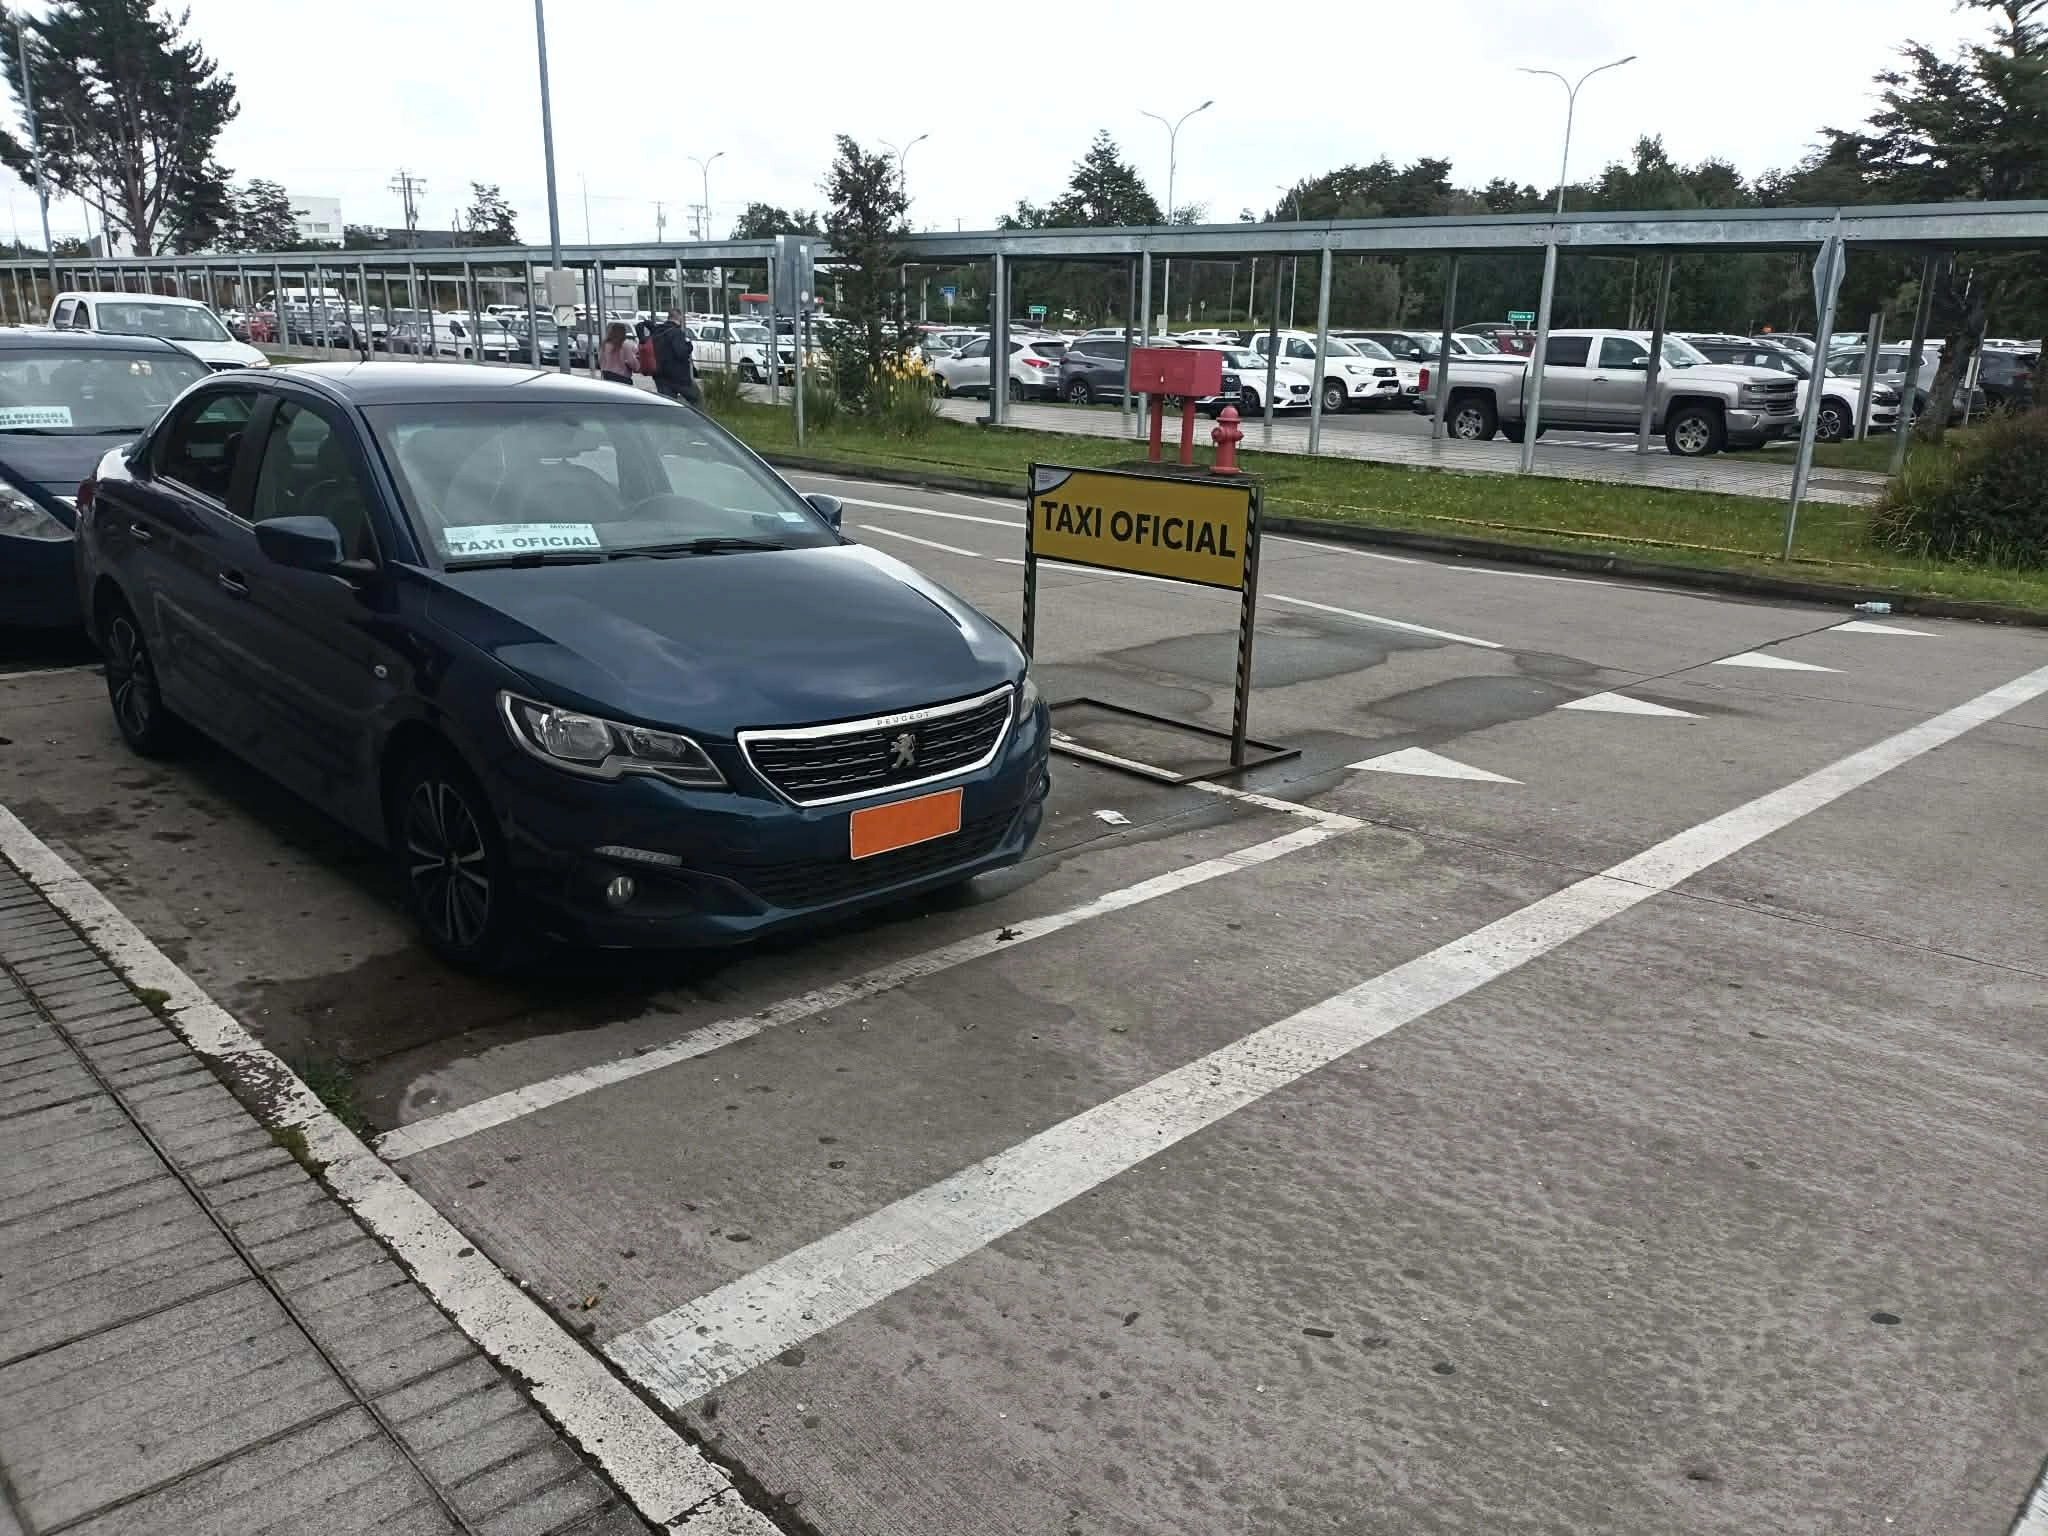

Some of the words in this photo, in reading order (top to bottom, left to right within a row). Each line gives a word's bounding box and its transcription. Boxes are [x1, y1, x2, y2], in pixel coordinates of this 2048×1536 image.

[1040, 499, 1103, 538] TAXI
[1109, 509, 1237, 559] OFICIAL
[452, 538, 504, 553] TAXI
[512, 536, 599, 548] OFICIAL
[877, 711, 931, 726] PEUGEOT
